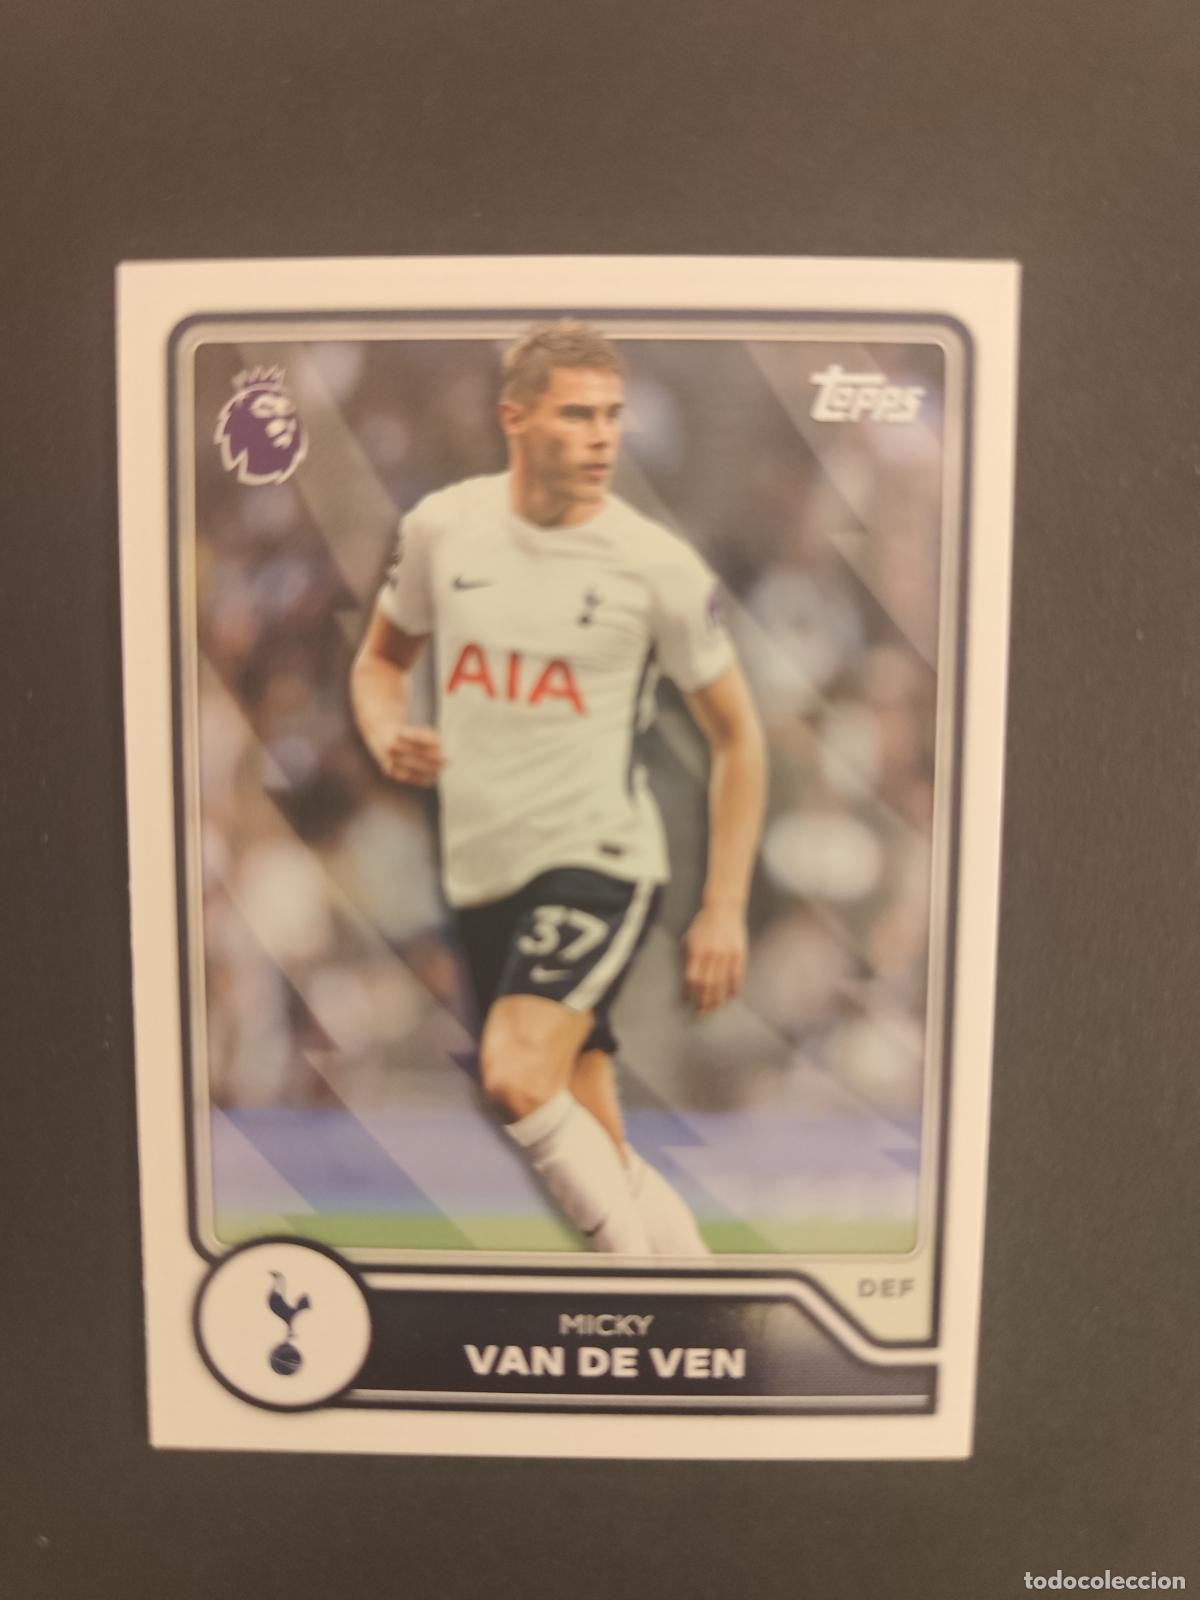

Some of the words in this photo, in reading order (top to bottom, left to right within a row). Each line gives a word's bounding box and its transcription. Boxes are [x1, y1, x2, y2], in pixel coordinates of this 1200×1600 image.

[446, 641, 588, 715] AIA
[517, 904, 609, 963] 37
[857, 1278, 915, 1298] DEF
[558, 1313, 655, 1337] MICKY
[463, 1344, 565, 1378] VAN
[577, 1346, 639, 1378] DE
[650, 1347, 747, 1379] VEN
